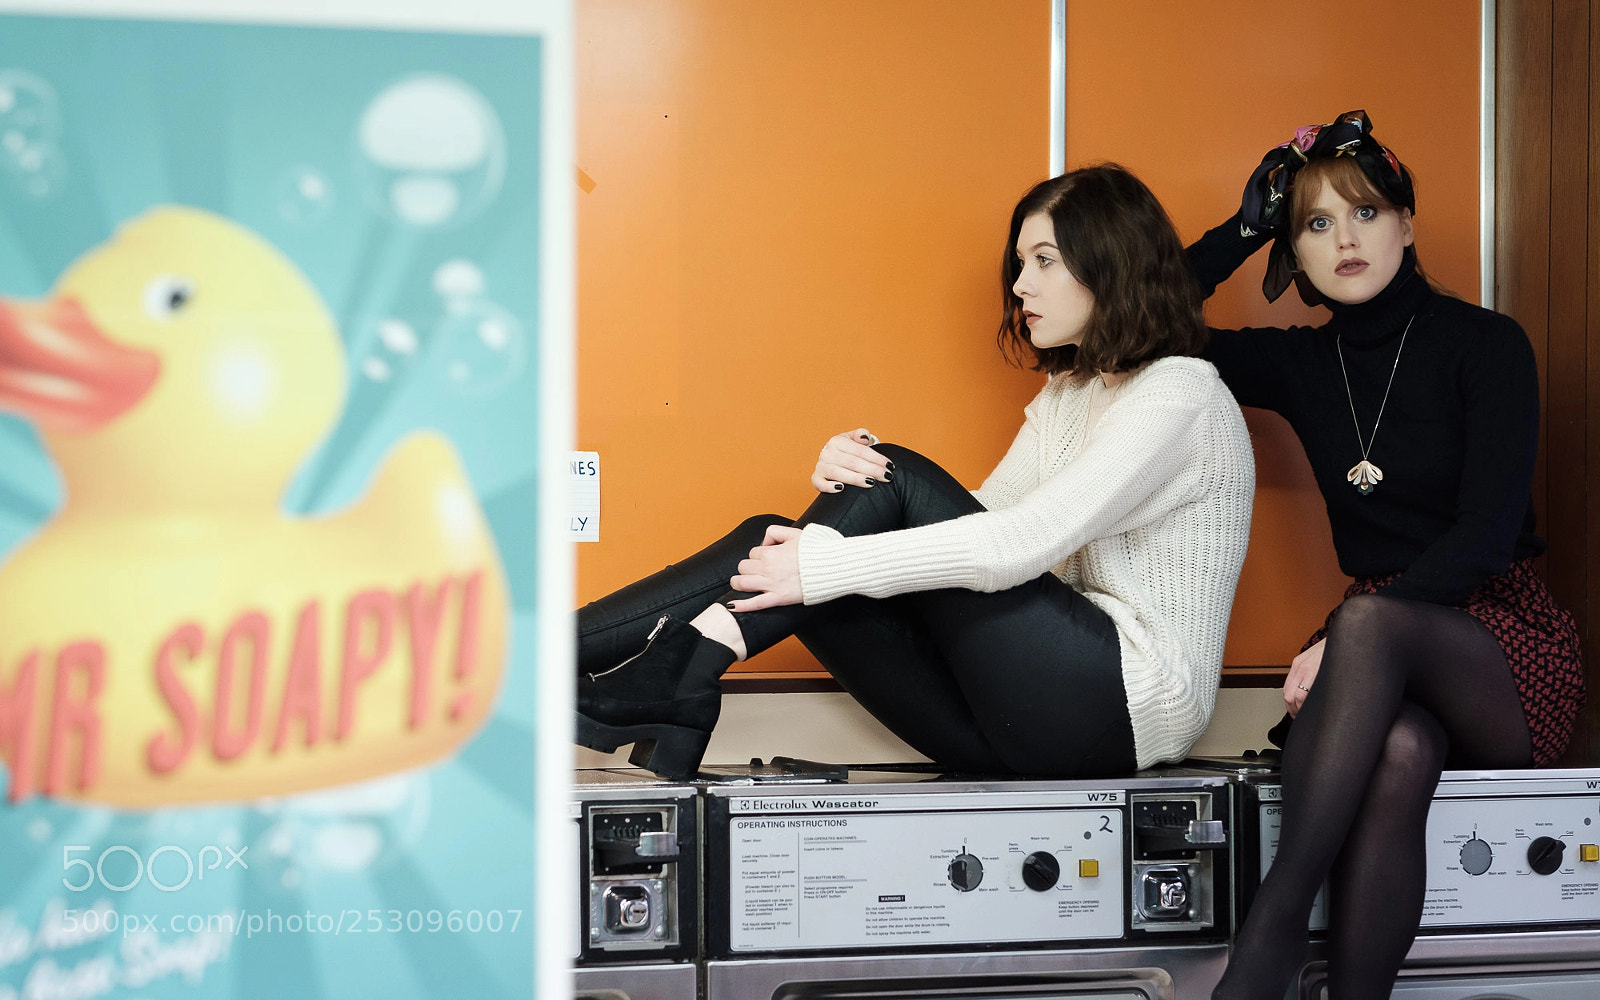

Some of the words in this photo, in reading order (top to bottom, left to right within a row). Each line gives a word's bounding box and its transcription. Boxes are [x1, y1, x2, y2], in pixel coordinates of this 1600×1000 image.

[146, 570, 485, 777] SOAPY!
[1586, 781, 1600, 789] W
[1087, 793, 1117, 802] W75
[753, 800, 808, 810] Electrolux
[812, 800, 879, 808] Wascator
[788, 820, 848, 828] INSTRUCTIONS
[1099, 815, 1113, 833] 2
